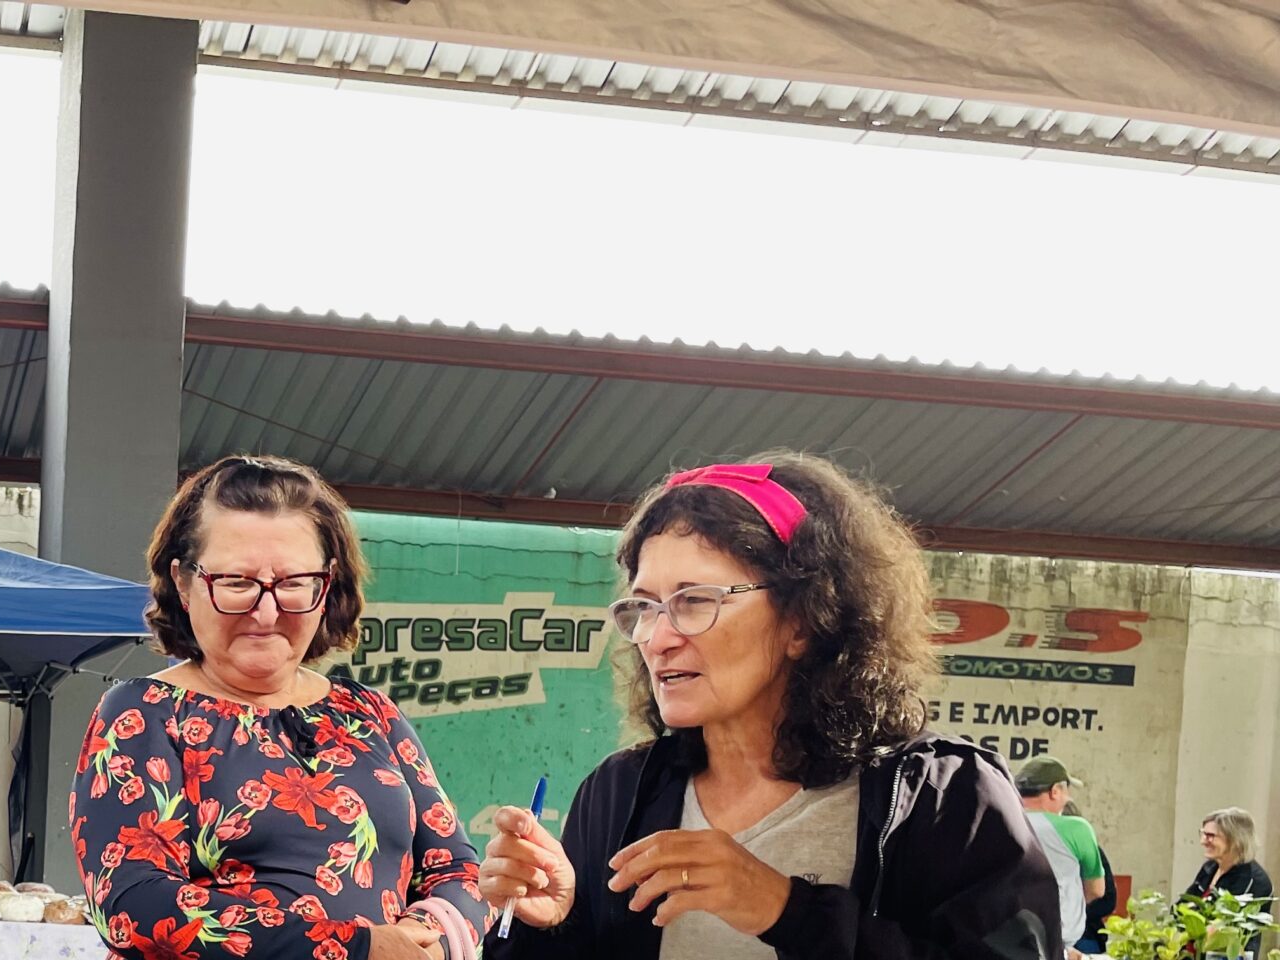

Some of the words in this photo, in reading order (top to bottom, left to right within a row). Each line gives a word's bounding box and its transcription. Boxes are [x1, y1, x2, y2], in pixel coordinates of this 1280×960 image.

[942, 659, 1114, 682] OMOTIVOS
[949, 702, 964, 722] E
[973, 703, 1103, 731] IMPORT.
